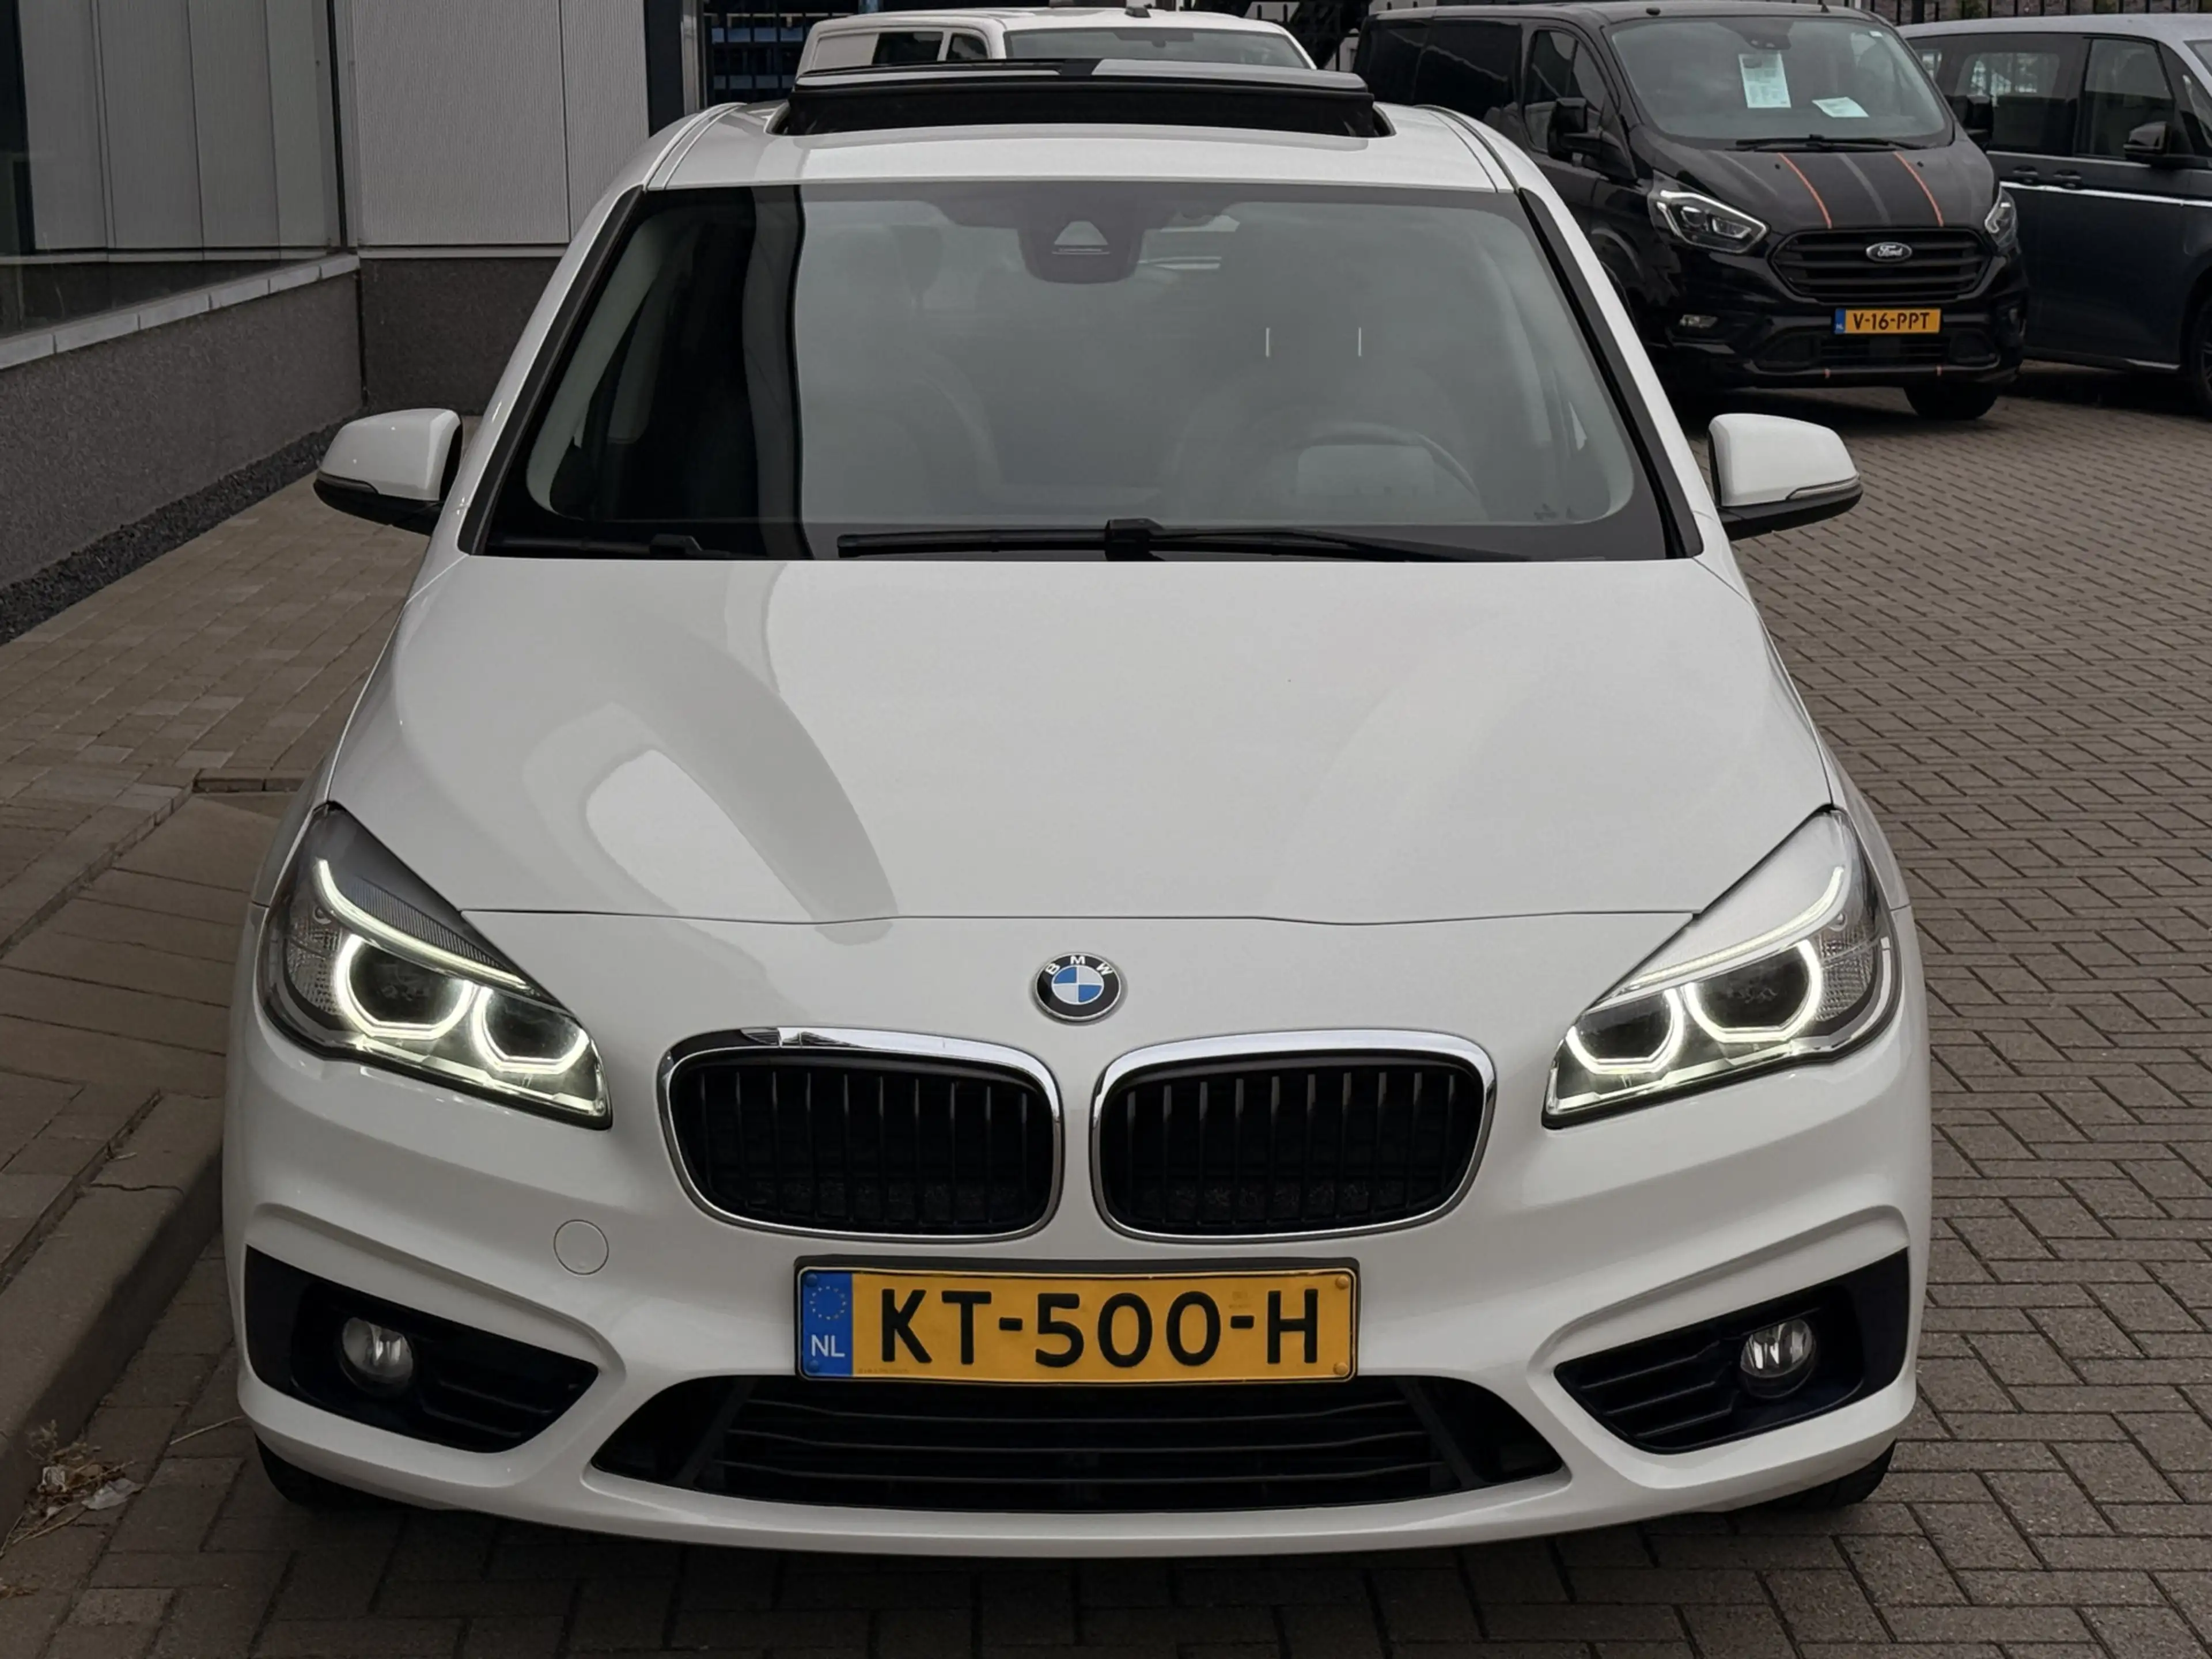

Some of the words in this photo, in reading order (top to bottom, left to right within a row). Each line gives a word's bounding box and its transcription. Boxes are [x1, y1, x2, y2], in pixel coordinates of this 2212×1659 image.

[1877, 245, 1903, 257] Ford
[1853, 312, 1930, 330] V-16-PPT
[1045, 955, 1113, 976] BMW
[881, 1287, 1319, 1369] KT-500-H
[811, 1334, 845, 1358] NL
